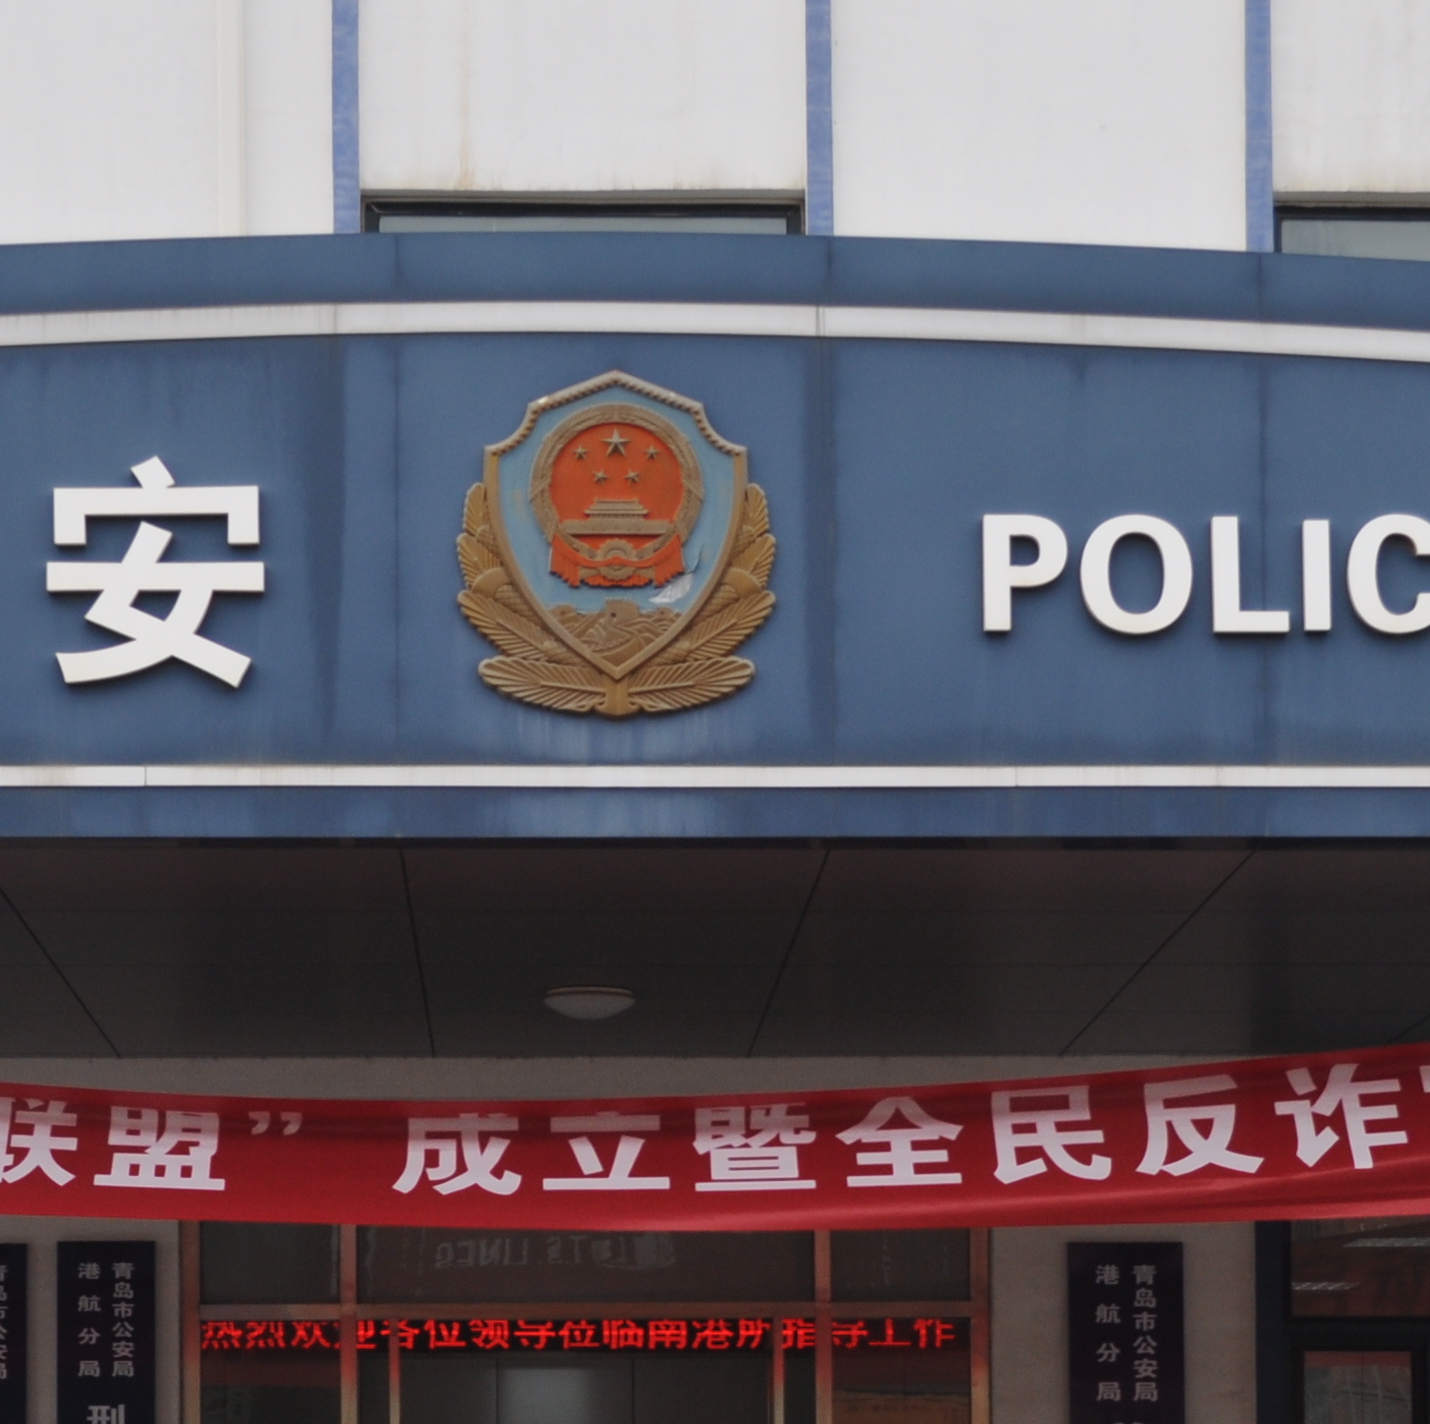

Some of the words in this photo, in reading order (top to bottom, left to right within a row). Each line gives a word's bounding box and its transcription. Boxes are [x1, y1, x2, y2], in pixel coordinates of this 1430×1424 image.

[77, 1262, 101, 1378] 港航分局
[111, 1262, 135, 1378] 青岛市公安局
[1095, 1265, 1121, 1402] 港航分局
[1132, 1265, 1159, 1402] 青岛市公安局
